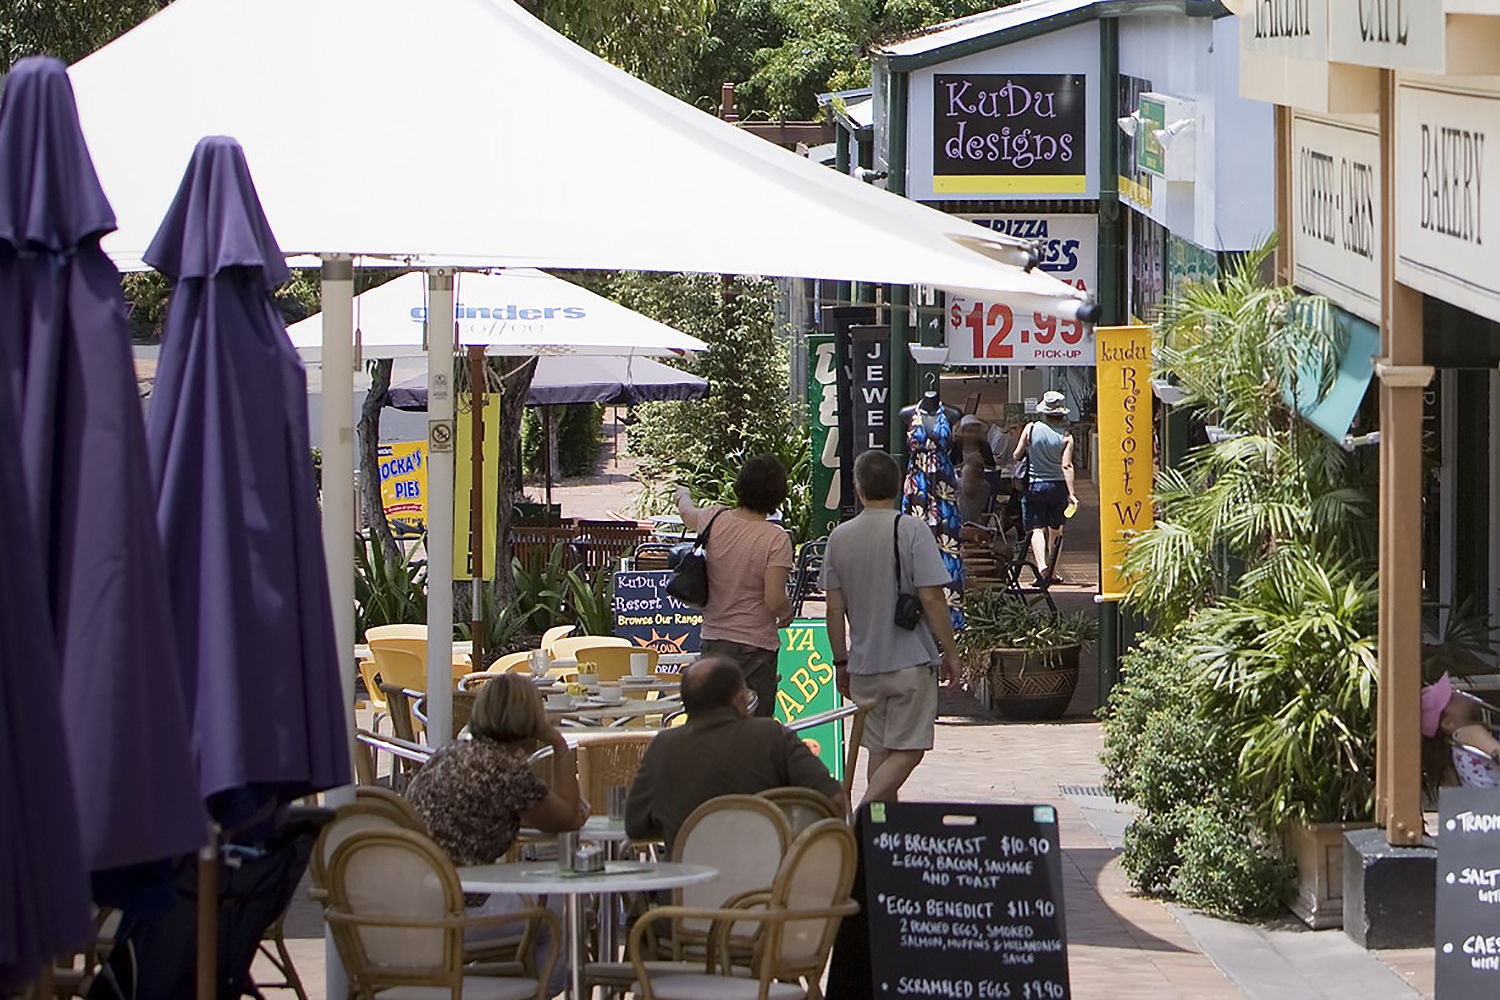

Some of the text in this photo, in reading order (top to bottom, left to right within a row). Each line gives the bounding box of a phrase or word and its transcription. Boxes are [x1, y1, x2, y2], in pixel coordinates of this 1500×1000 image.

[944, 121, 1073, 169] designs
[1420, 124, 1485, 246] BAKERY
[410, 303, 587, 323] ginders
[1034, 349, 1082, 359] PICK-UP
[1101, 340, 1148, 362] kudu
[378, 449, 422, 482] OCKA'S
[394, 480, 420, 500] PIES
[615, 596, 663, 613] Resort
[617, 613, 704, 626] Browse Our Range
[785, 628, 816, 652] YA
[879, 833, 1050, 856] BIG BREAKFAST $10.90
[984, 859, 1033, 875] SAUSAGE
[923, 871, 1000, 888] AND TOAST
[886, 896, 1055, 919] EGGS BENEDICT $11.90
[900, 920, 910, 933] 2
[986, 924, 1034, 940] SMOKED
[1471, 956, 1499, 970] WITH
[897, 977, 974, 998] SCRAMBLED
[979, 982, 1011, 997] EGGS
